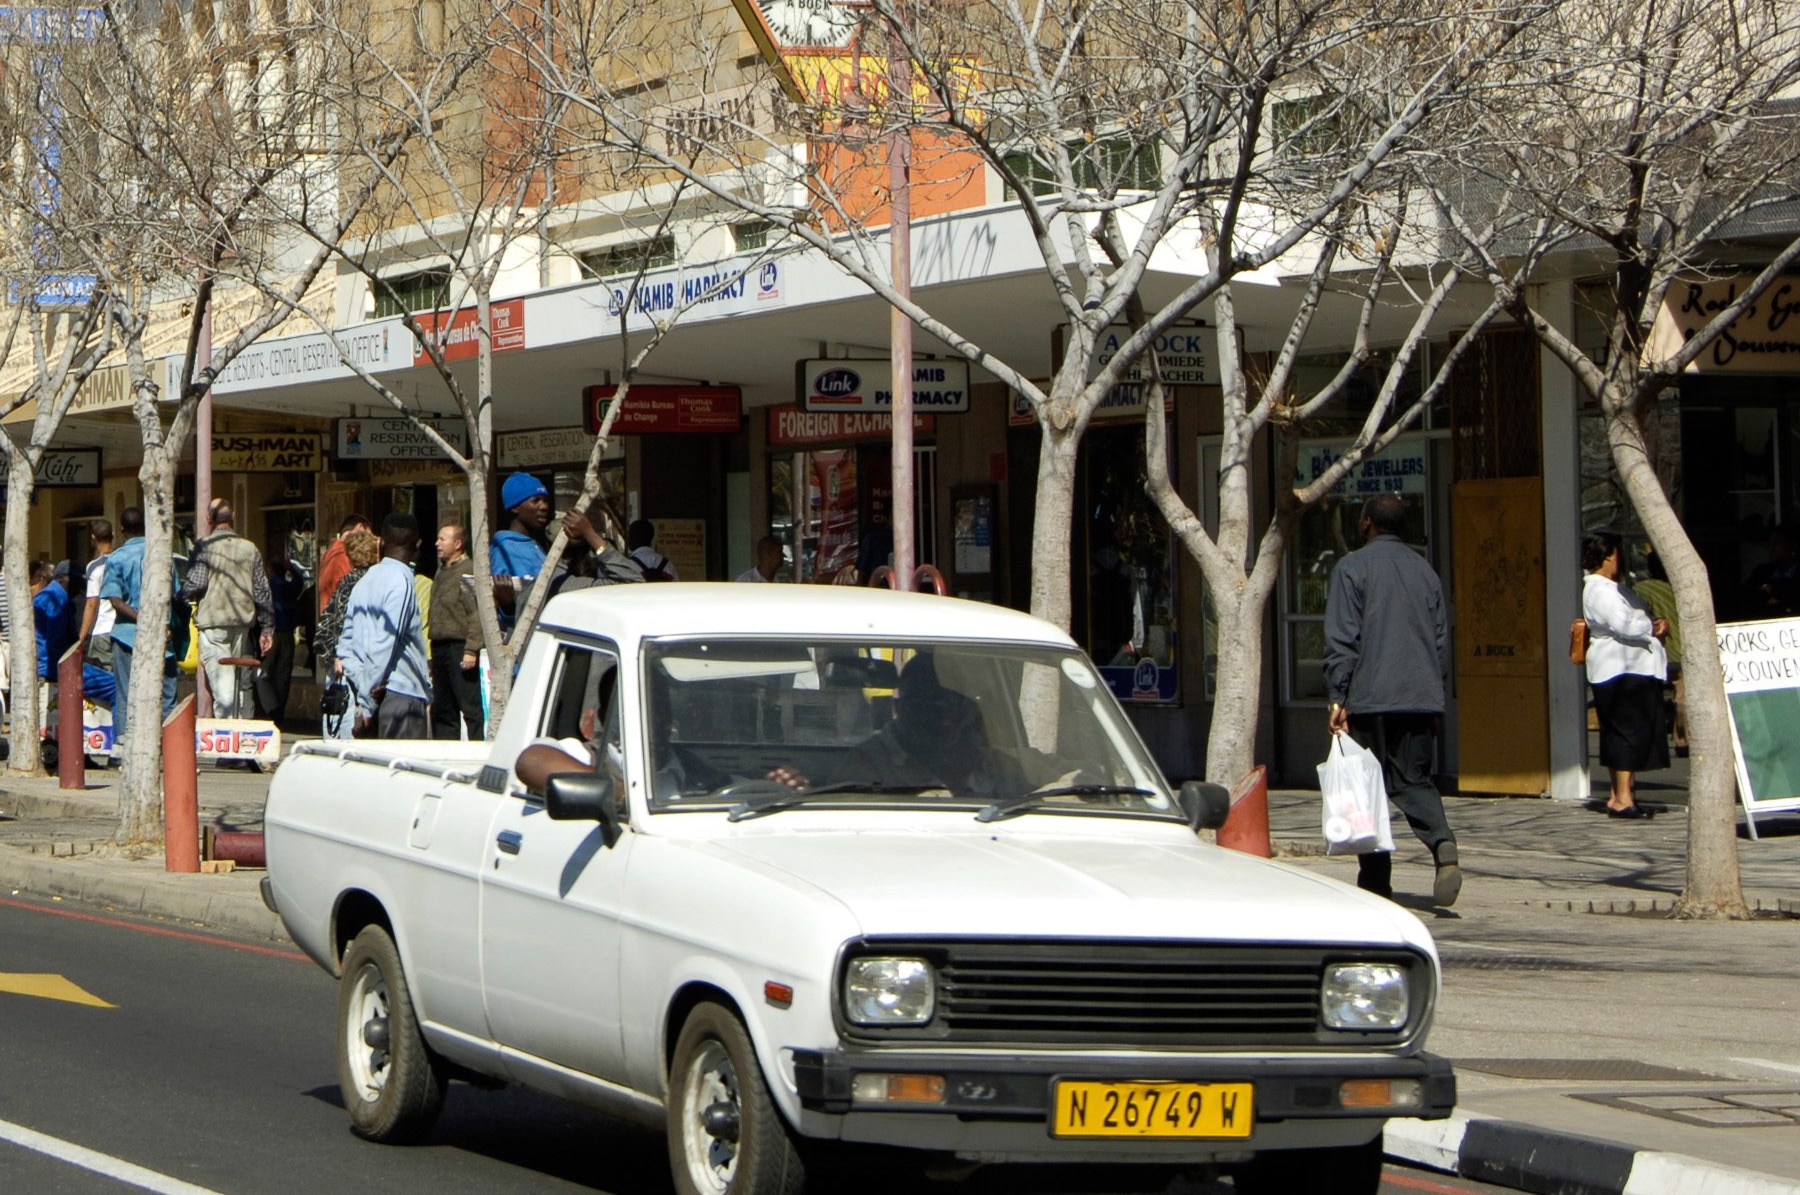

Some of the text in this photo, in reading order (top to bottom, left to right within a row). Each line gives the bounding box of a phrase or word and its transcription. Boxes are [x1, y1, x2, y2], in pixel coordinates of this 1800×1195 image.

[634, 282, 674, 314] NAMIB
[1104, 334, 1202, 353] A OCK
[269, 346, 303, 376] CENTRAL
[350, 334, 381, 364] OFFICE
[820, 373, 852, 392] Link
[912, 368, 946, 383] AMIB
[680, 398, 713, 406] Thomas
[874, 390, 963, 405] PHRMACY
[690, 404, 712, 412] Cook
[382, 420, 445, 431] CENTAL
[778, 410, 840, 439] FOREIGN
[390, 445, 438, 457] OFFICE
[506, 435, 537, 452] CENTRAL
[272, 453, 314, 468] ART
[1360, 456, 1425, 478] JEWELLERS
[1069, 1089, 1238, 1129] N 26749 W
